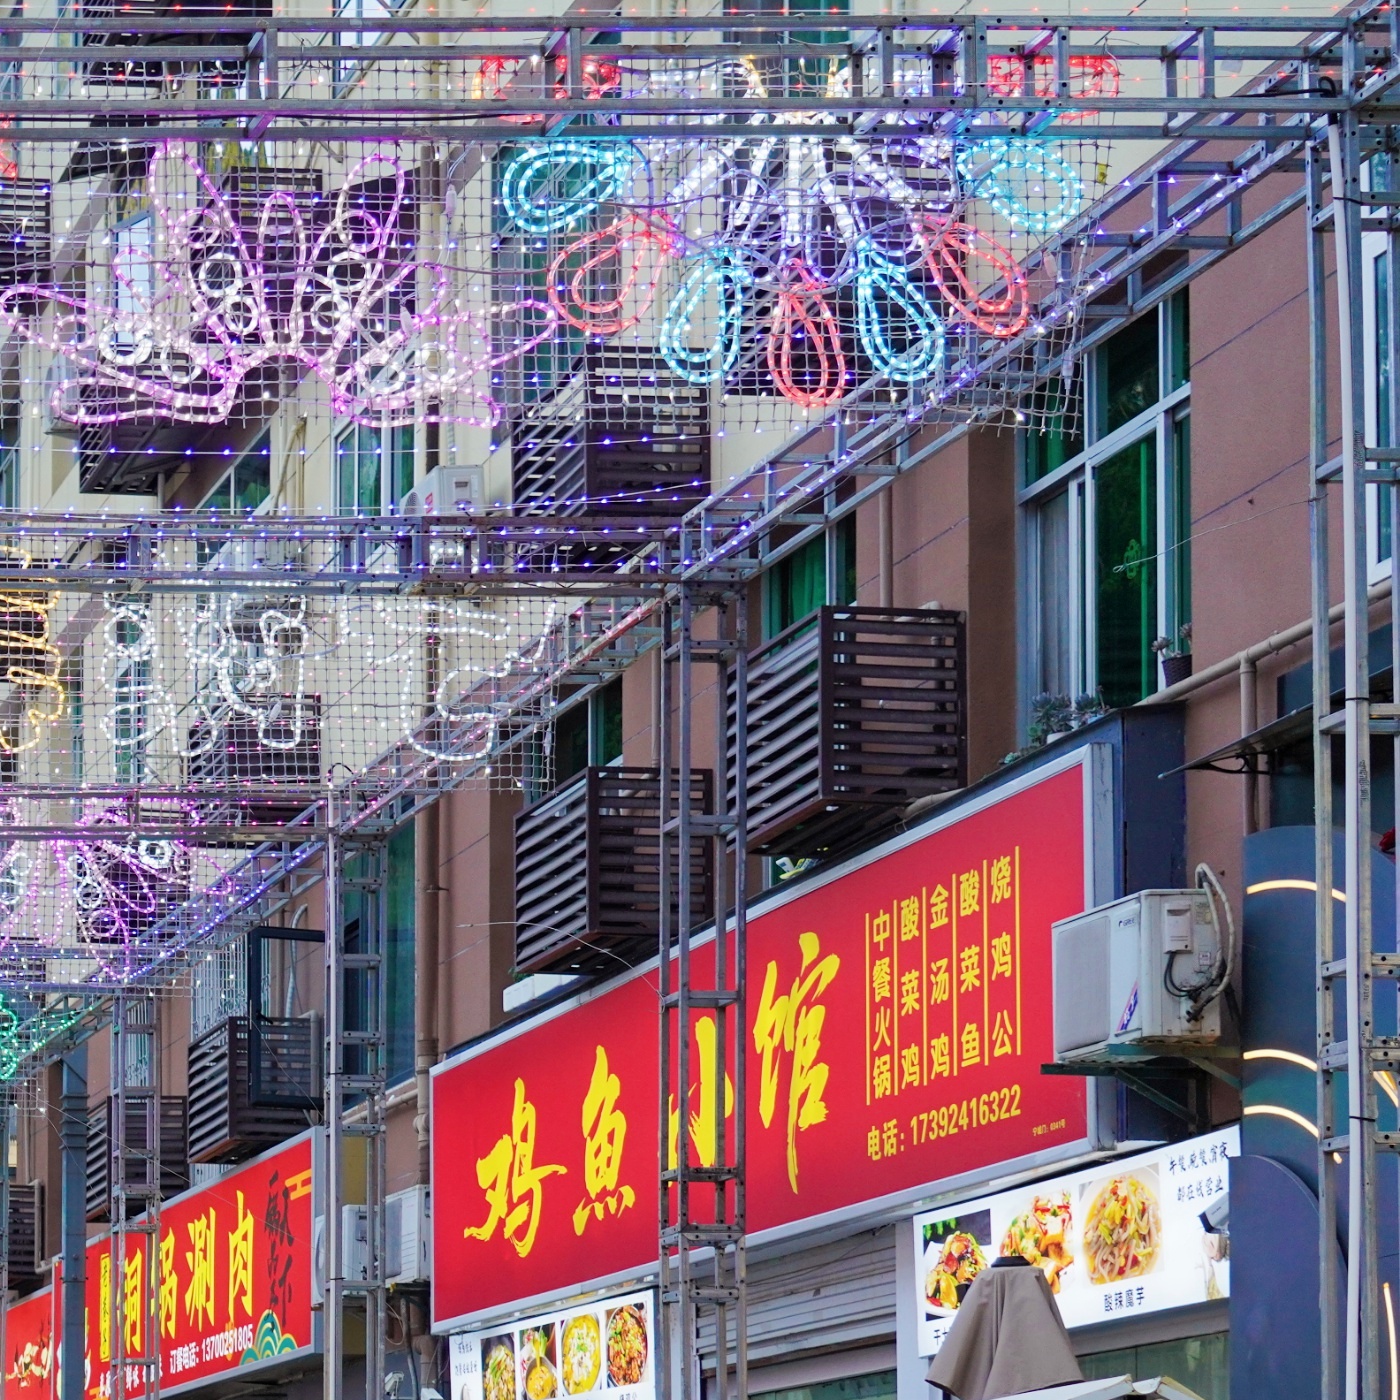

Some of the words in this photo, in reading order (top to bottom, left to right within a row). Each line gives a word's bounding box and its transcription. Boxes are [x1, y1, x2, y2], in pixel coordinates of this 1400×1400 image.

[872, 909, 891, 1099] 中餐火锅
[900, 895, 920, 1090] 酸菜鸡
[930, 883, 949, 1081] 金汤鸡
[959, 869, 981, 1068] 酸菜鱼
[990, 855, 1013, 1058] 烧鸡公
